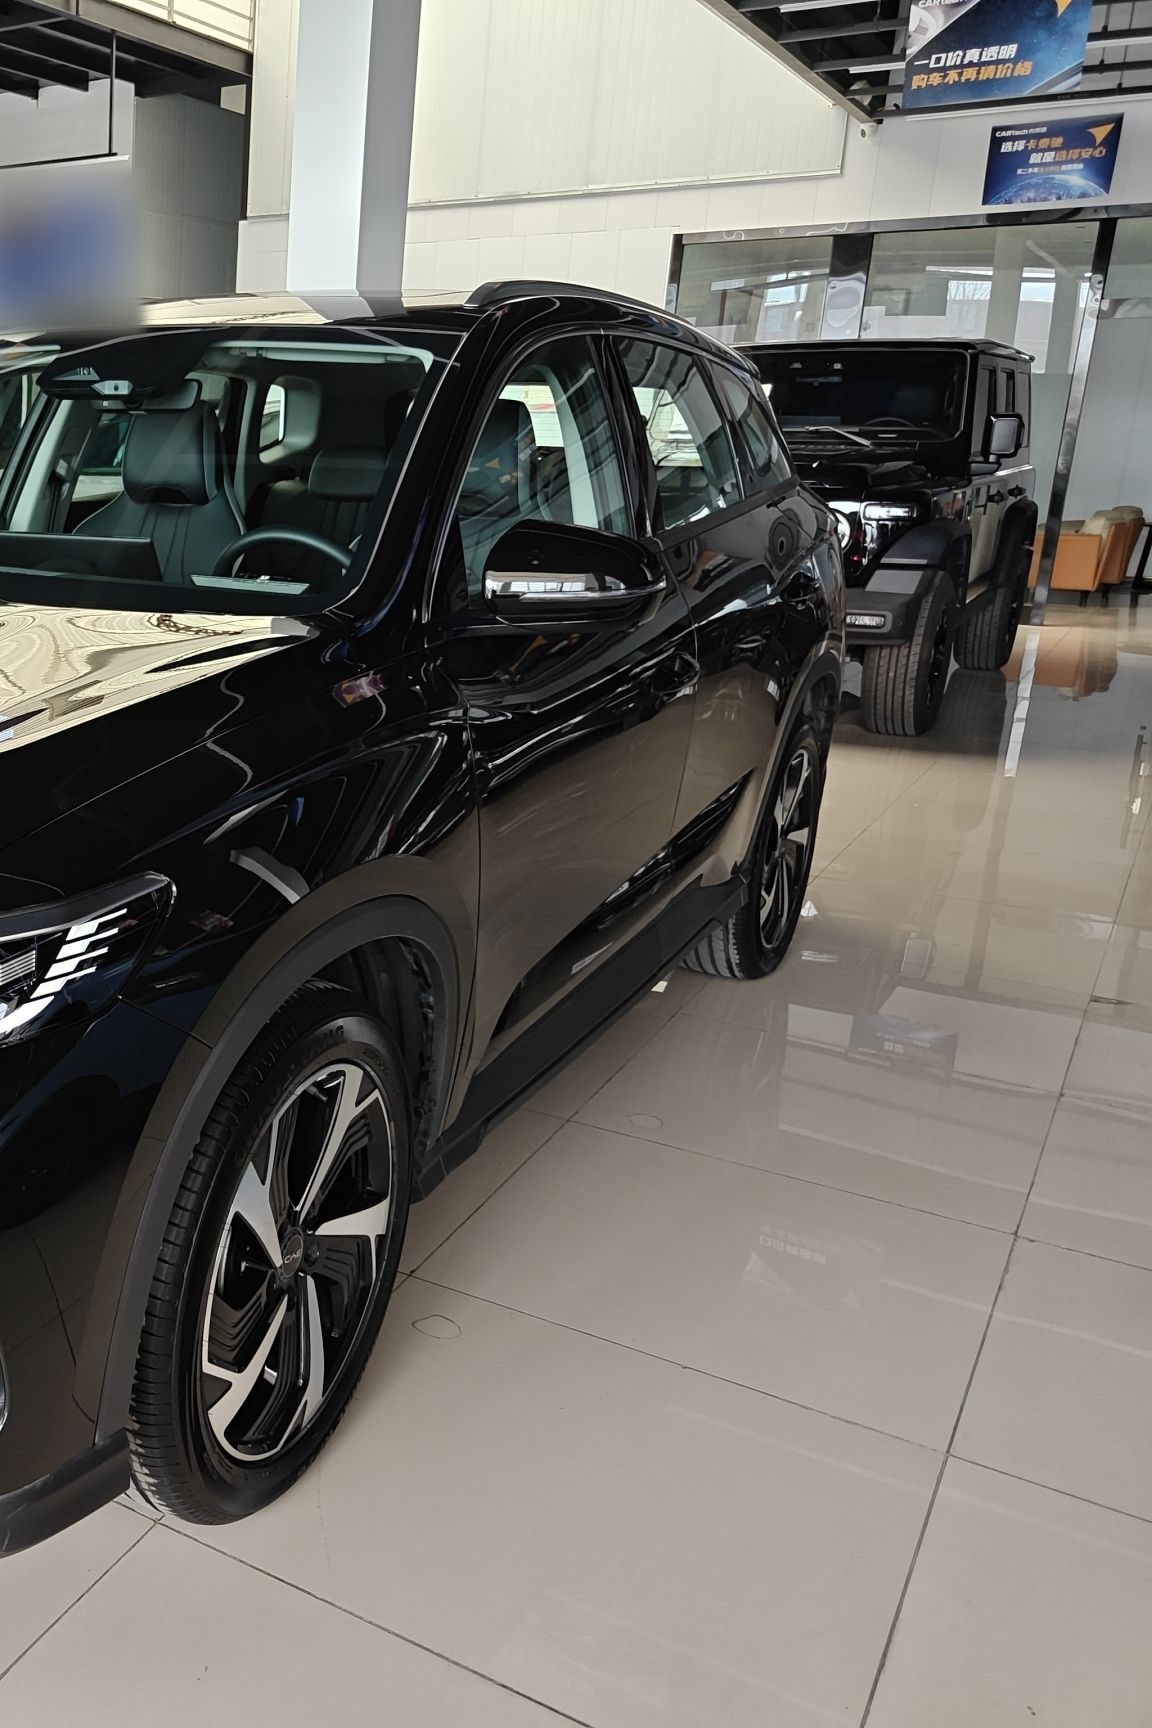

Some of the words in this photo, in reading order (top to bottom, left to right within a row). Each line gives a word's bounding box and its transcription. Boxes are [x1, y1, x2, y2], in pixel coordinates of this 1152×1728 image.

[914, 44, 1018, 68] 一口价真透明
[911, 60, 1033, 90] 购车不再猜价格
